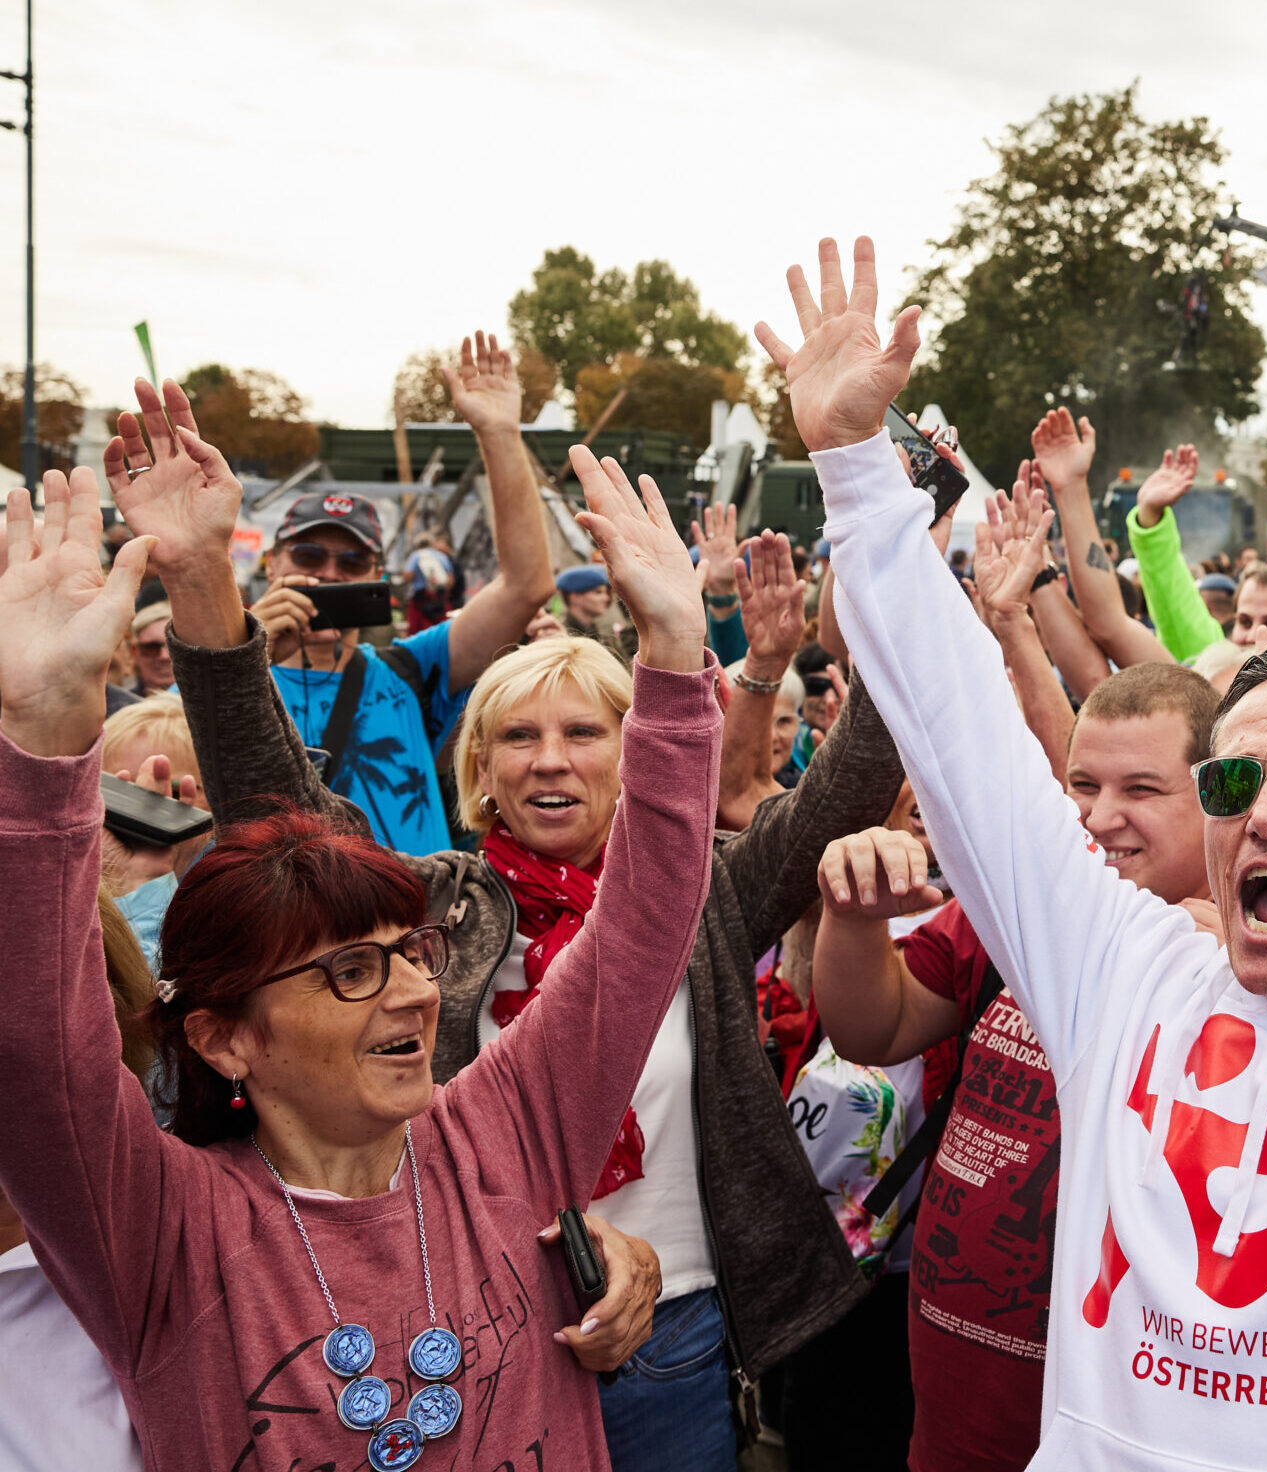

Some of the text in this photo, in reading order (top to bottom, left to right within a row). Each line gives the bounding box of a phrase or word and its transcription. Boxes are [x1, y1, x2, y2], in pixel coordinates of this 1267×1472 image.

[986, 1032, 1051, 1071] BROADCAS
[963, 1118, 983, 1134] BEST
[982, 1128, 1014, 1148] BANDS
[1013, 1141, 1030, 1153] ON
[971, 1135, 997, 1152] OVER
[997, 1146, 1030, 1164] THREE
[964, 1145, 994, 1164] HEART
[993, 1159, 1009, 1169] OF
[1142, 1305, 1184, 1346] WIR
